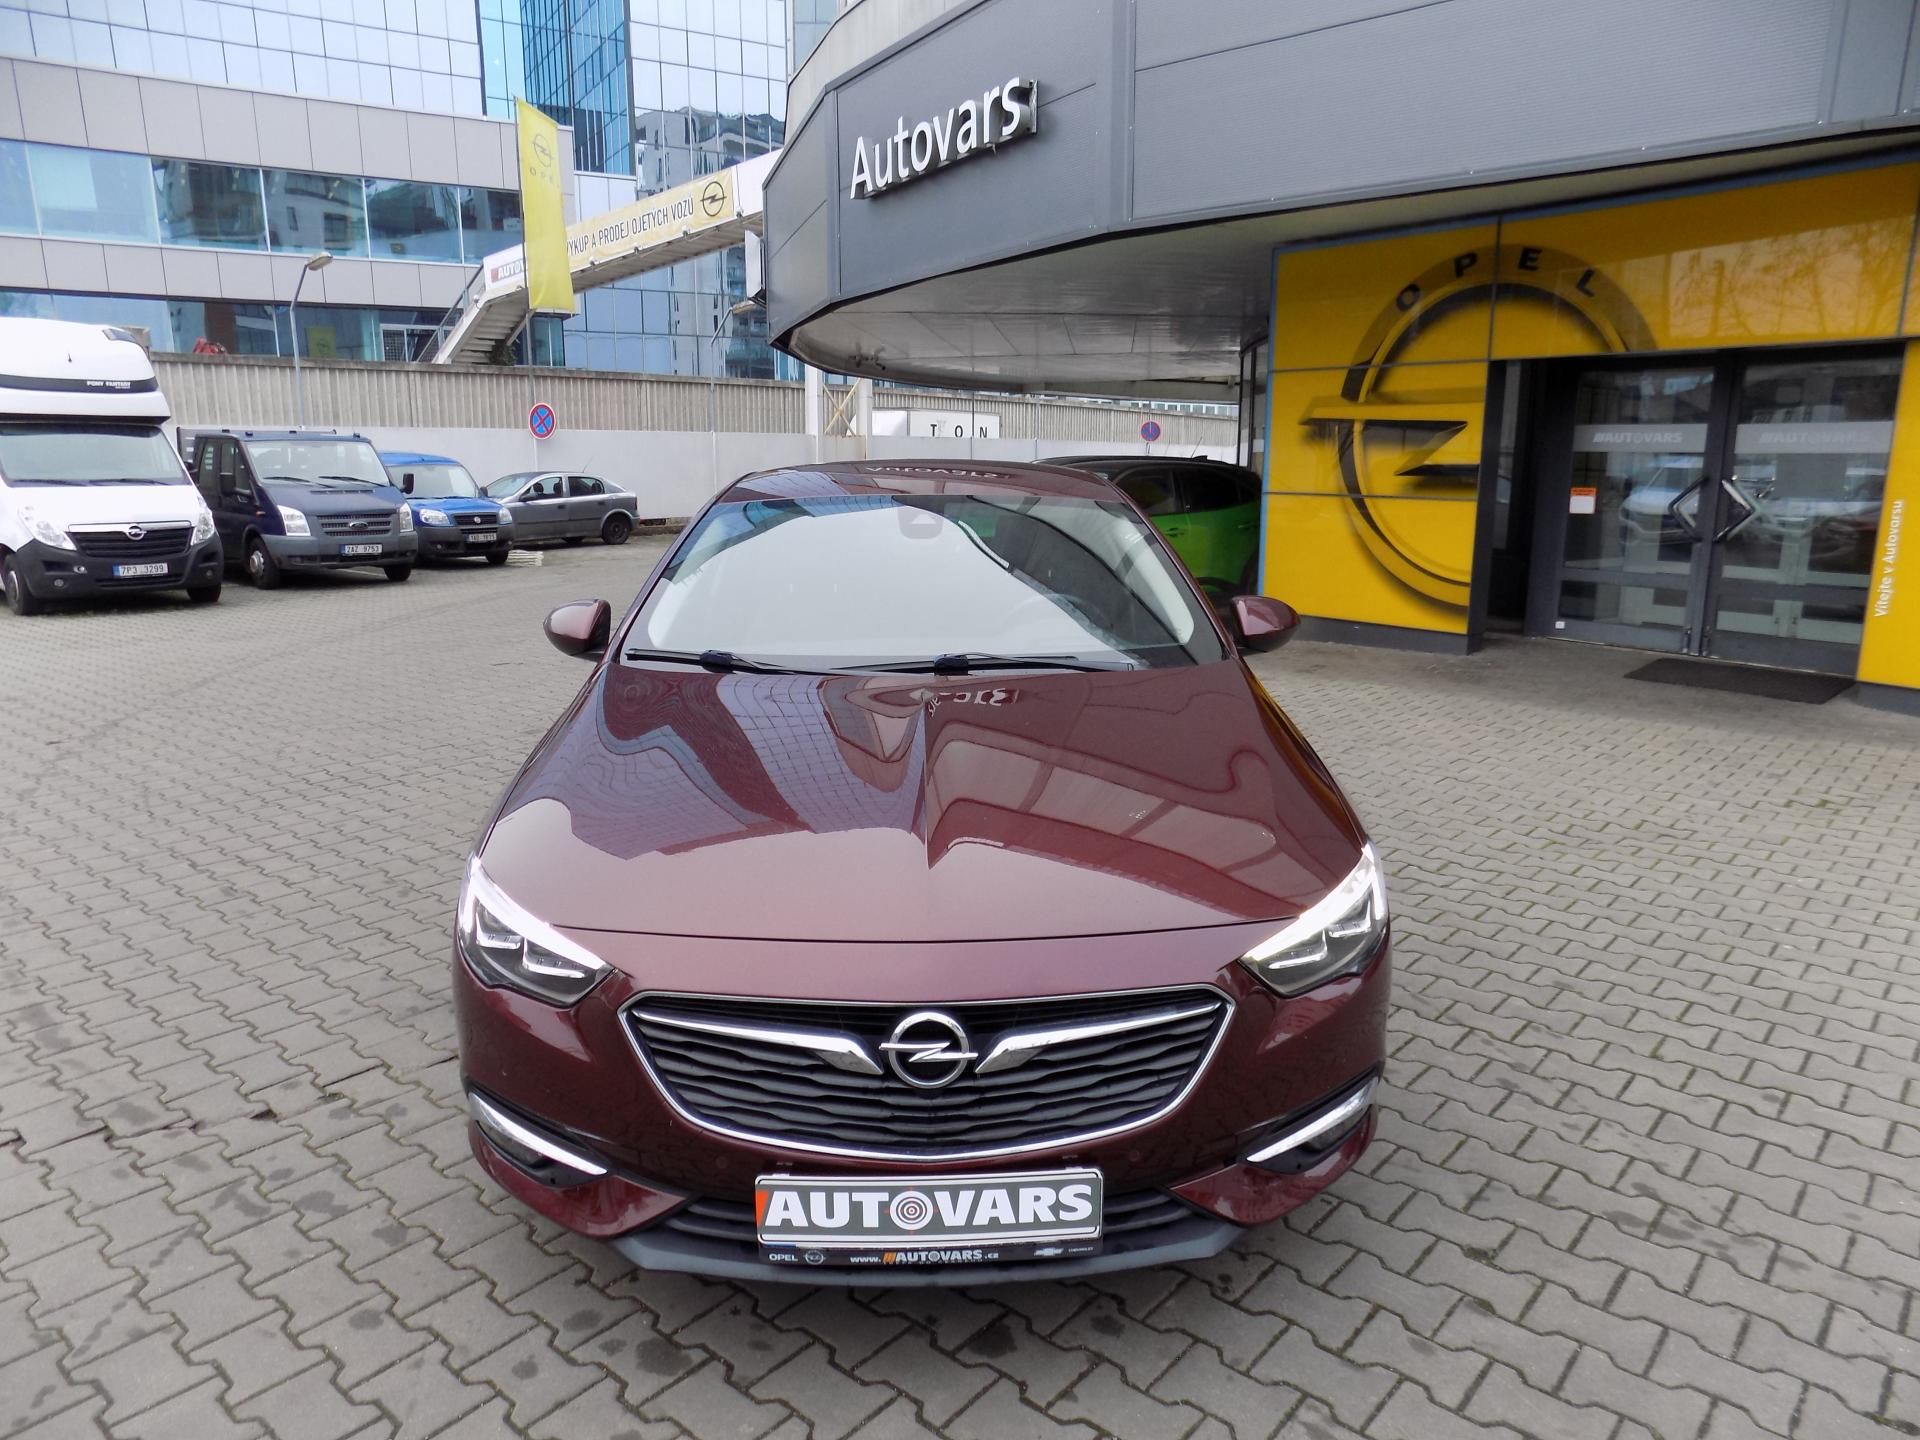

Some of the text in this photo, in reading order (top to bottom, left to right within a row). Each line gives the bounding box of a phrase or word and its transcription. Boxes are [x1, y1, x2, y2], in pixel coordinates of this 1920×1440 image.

[850, 76, 1022, 200] Autovars
[591, 232, 597, 249] A
[599, 220, 630, 246] PRODEJ
[631, 207, 669, 235] OJETÝCH
[1396, 247, 1596, 312] OPEL
[1602, 432, 1683, 444] AUTOVARS
[121, 564, 164, 575] 7P3 3299
[1873, 500, 1904, 617] Vítejte v Autovarsu
[764, 1184, 1093, 1231] AUTOVARS
[769, 1253, 798, 1262] OPEL
